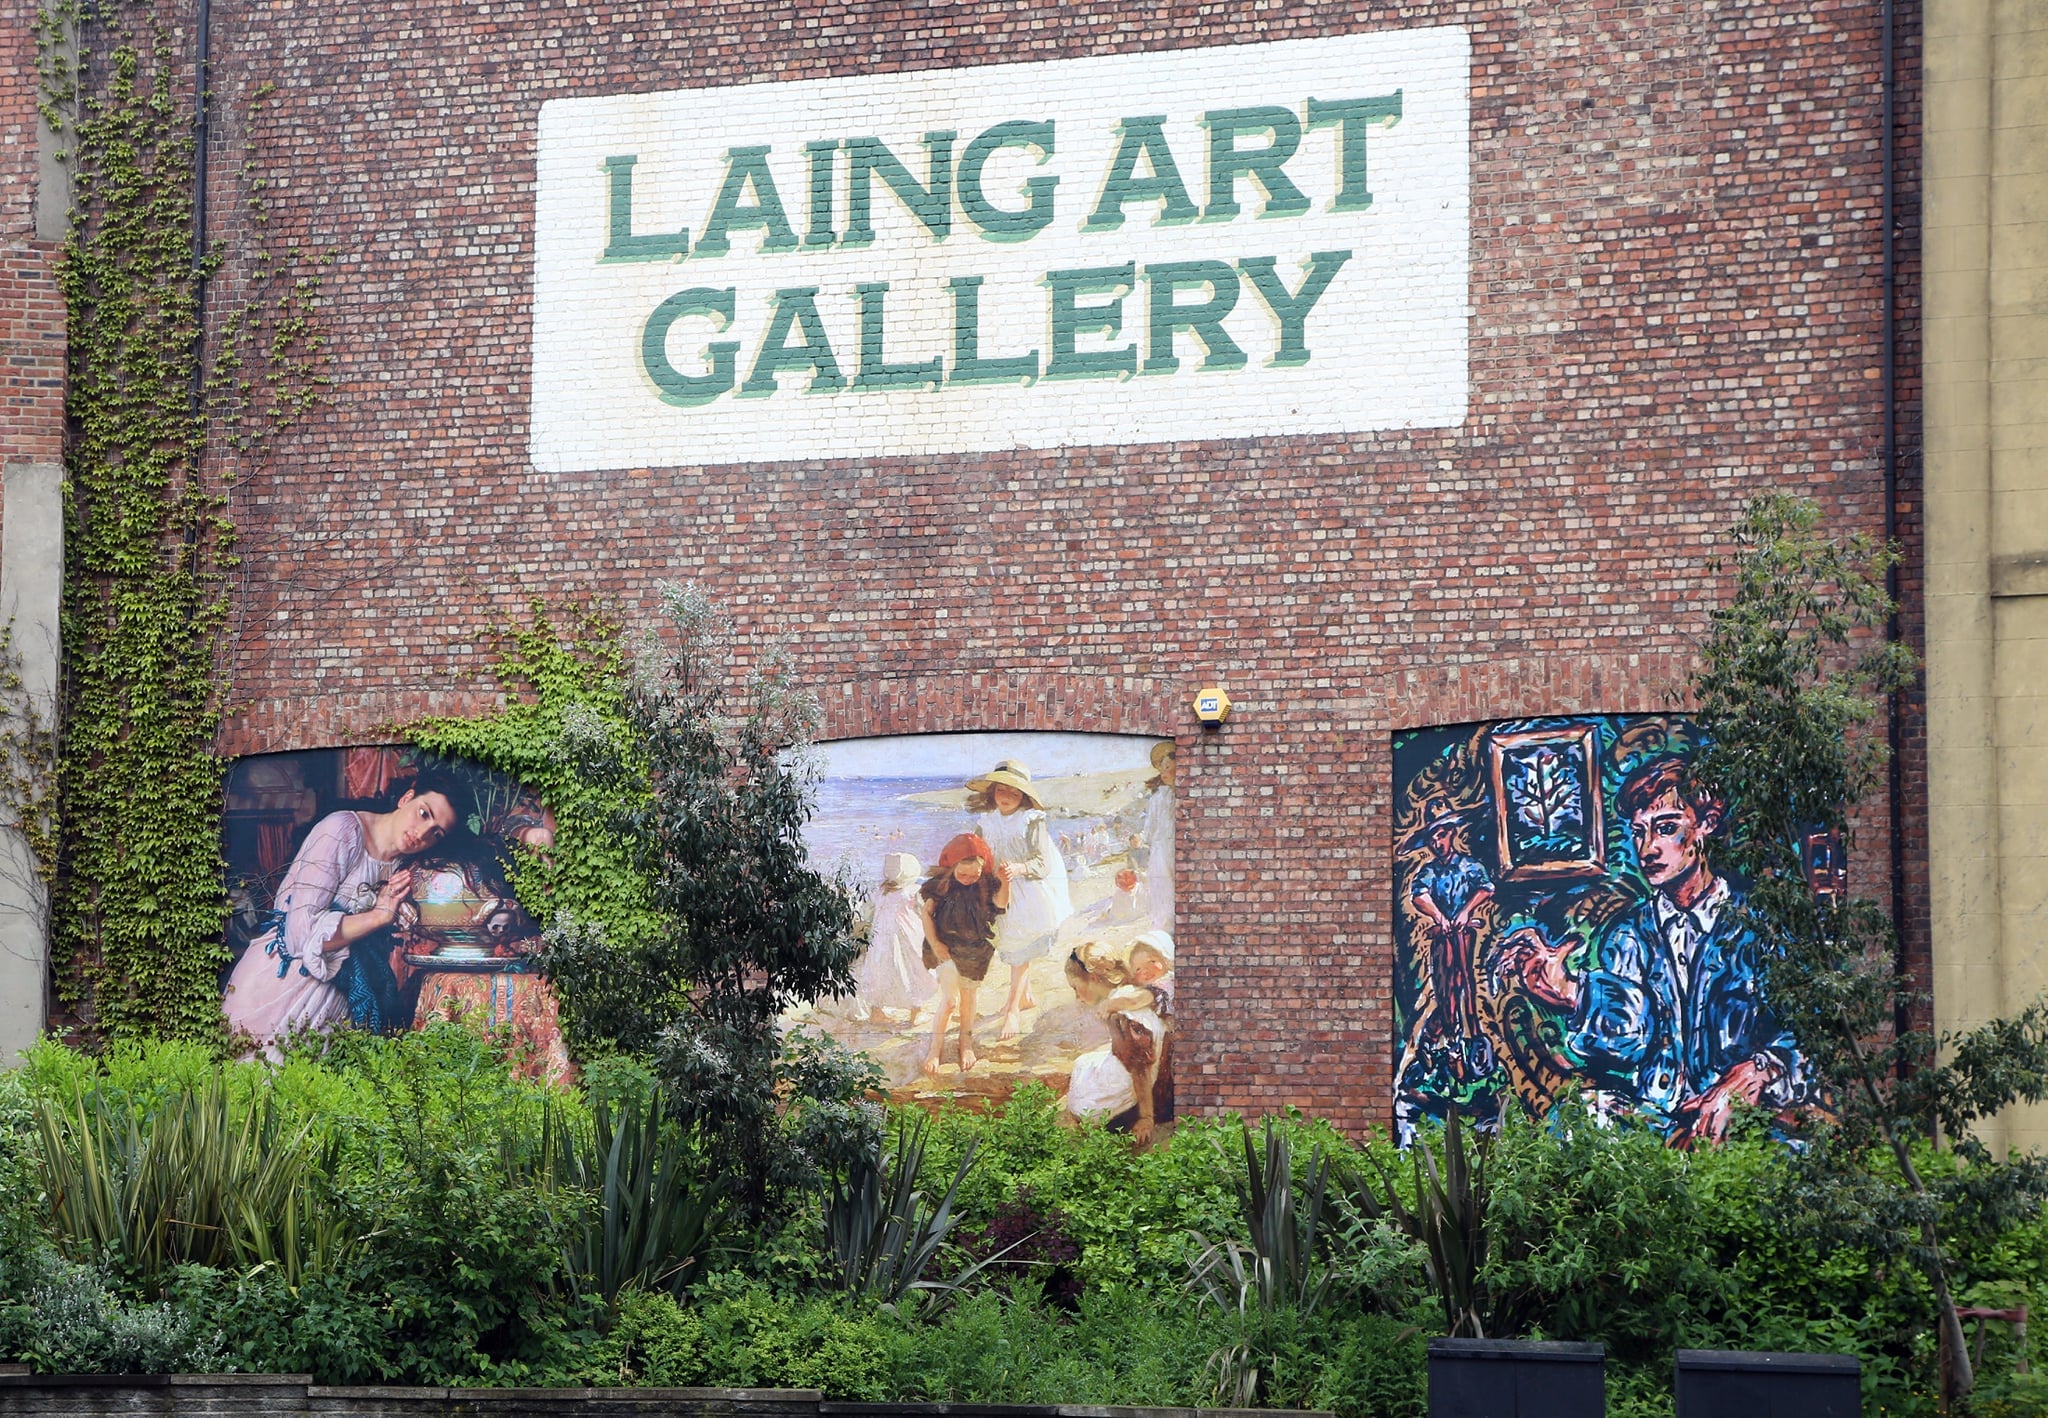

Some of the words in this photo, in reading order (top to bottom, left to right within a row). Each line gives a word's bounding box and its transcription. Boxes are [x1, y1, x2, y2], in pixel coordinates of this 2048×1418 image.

[597, 118, 1060, 265] LAING
[1080, 88, 1403, 233] ART
[638, 249, 1353, 408] GALLERY
